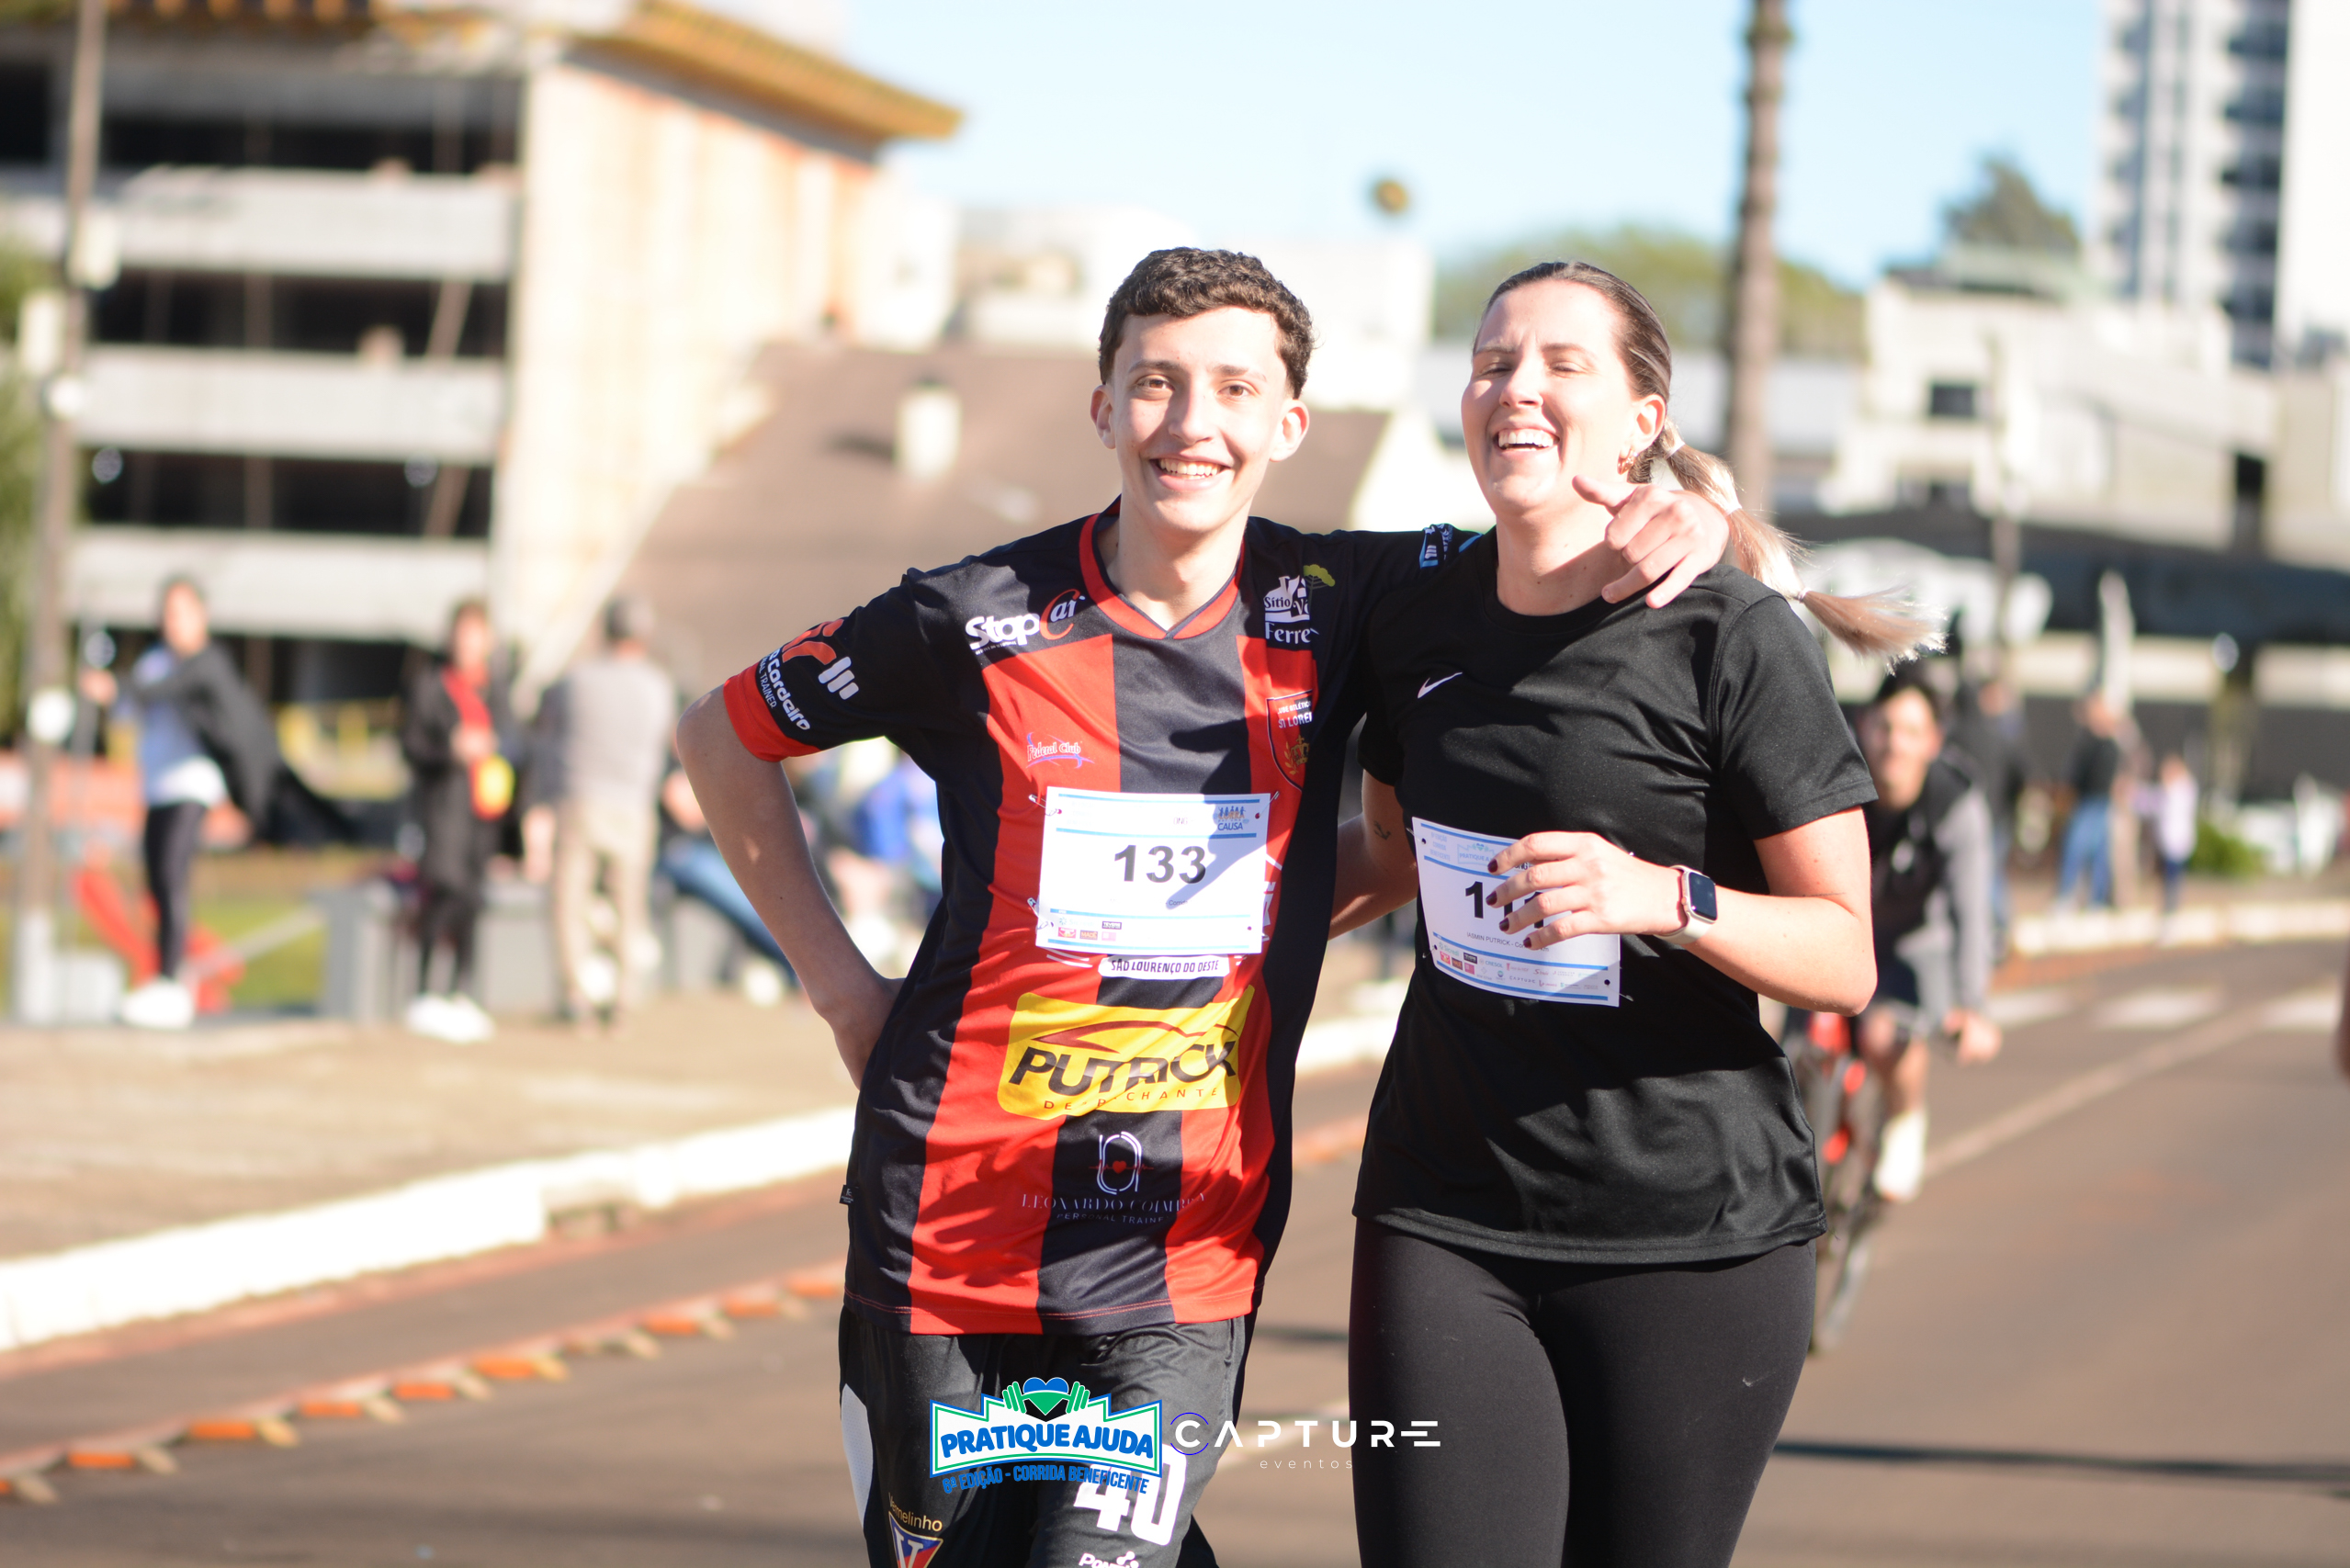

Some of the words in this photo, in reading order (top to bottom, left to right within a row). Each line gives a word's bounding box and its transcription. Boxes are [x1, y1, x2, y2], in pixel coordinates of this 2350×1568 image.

[1264, 596, 1291, 608] Sítio
[965, 613, 1041, 650] Stop
[1265, 621, 1319, 644] Ferre
[760, 672, 777, 709] TRAINER
[1026, 741, 1058, 762] Federal
[1058, 741, 1081, 755] Club
[1217, 822, 1244, 831] CAUSA
[1114, 845, 1206, 884] 133
[1459, 852, 1486, 862] PRATIQUE
[1486, 935, 1511, 947] PUTRICK
[1111, 958, 1130, 972] SÃO
[1131, 961, 1182, 975] LOURENÇO
[1182, 962, 1196, 973] DO
[1008, 1041, 1237, 1096] PUTRICK
[1073, 1442, 1187, 1546] 40
